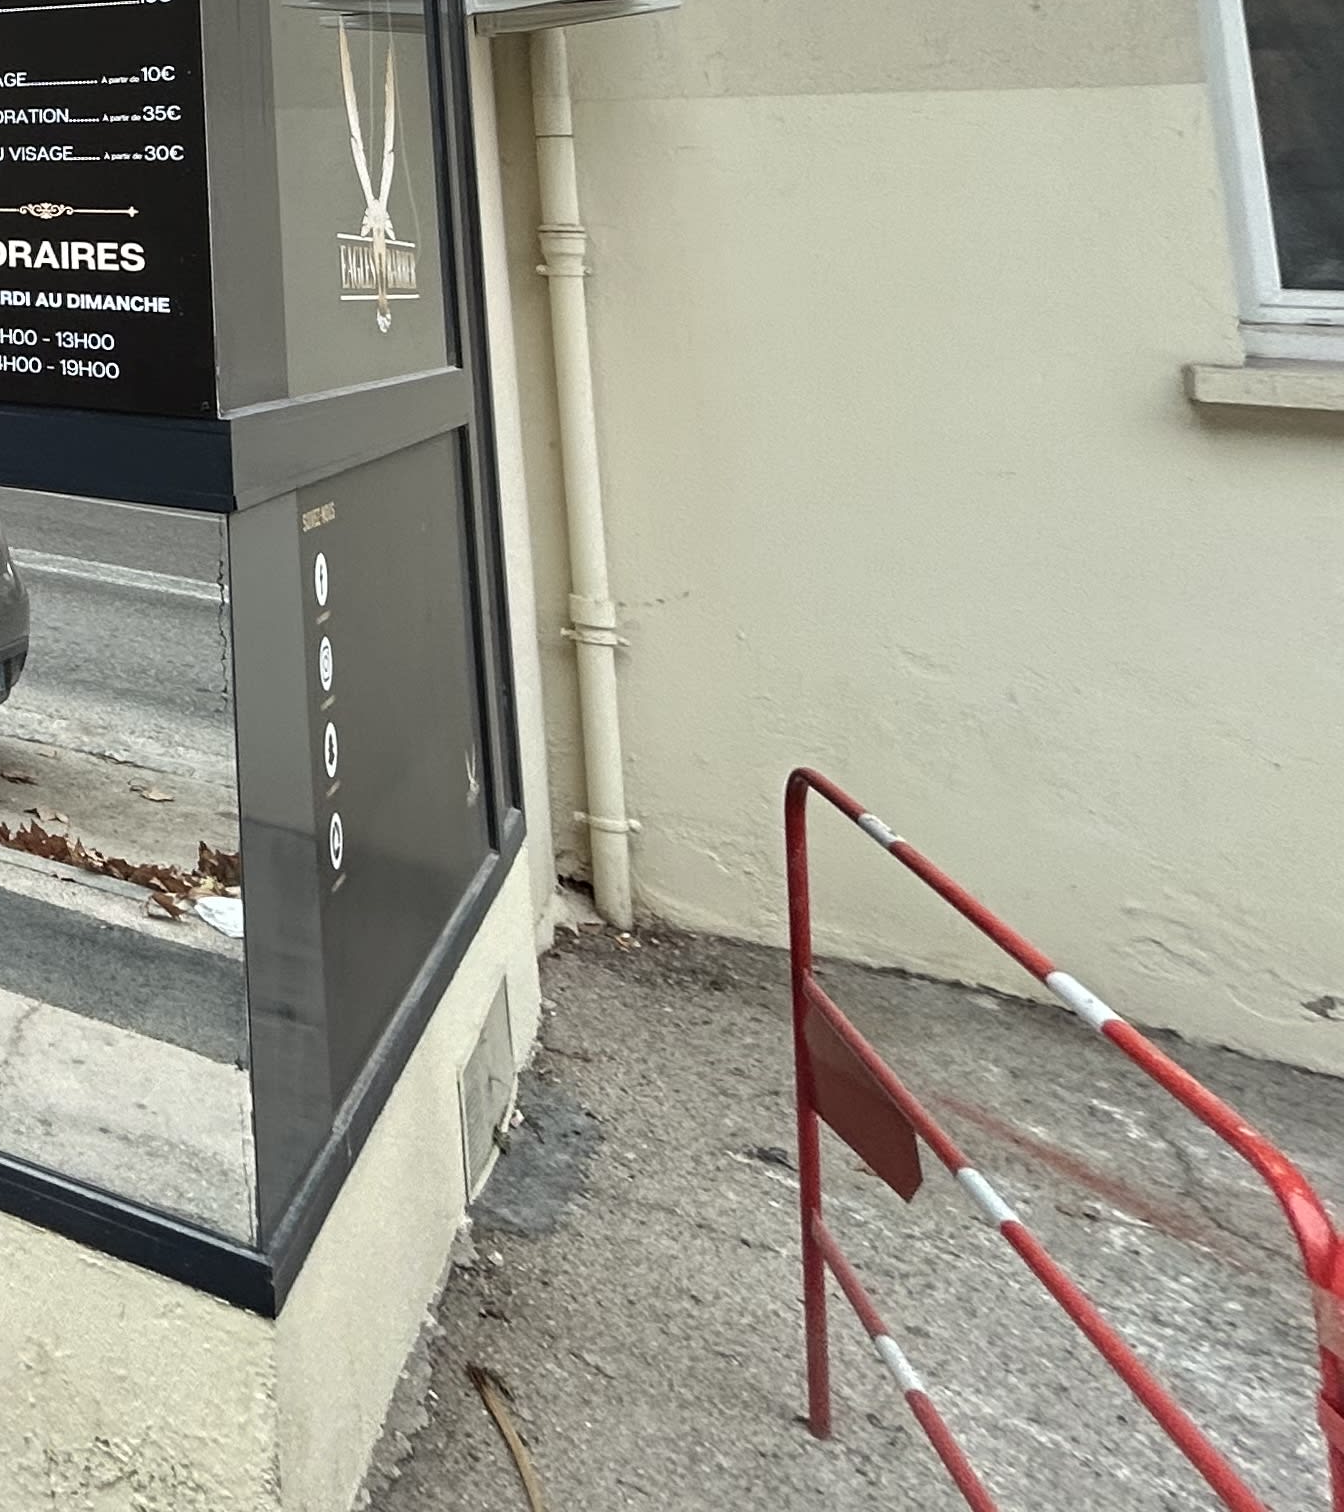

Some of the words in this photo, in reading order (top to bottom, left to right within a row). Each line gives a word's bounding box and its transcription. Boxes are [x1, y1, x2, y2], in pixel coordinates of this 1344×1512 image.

[140, 65, 176, 82] 10€
[142, 104, 182, 122] 35€
[8, 145, 74, 162] VISAGE
[144, 144, 185, 162] 30€
[340, 244, 377, 289] EAGLES
[35, 292, 63, 308] AU
[66, 293, 171, 313] DIMANCHE
[55, 331, 116, 351] 13H00
[59, 358, 121, 379] 19H00
